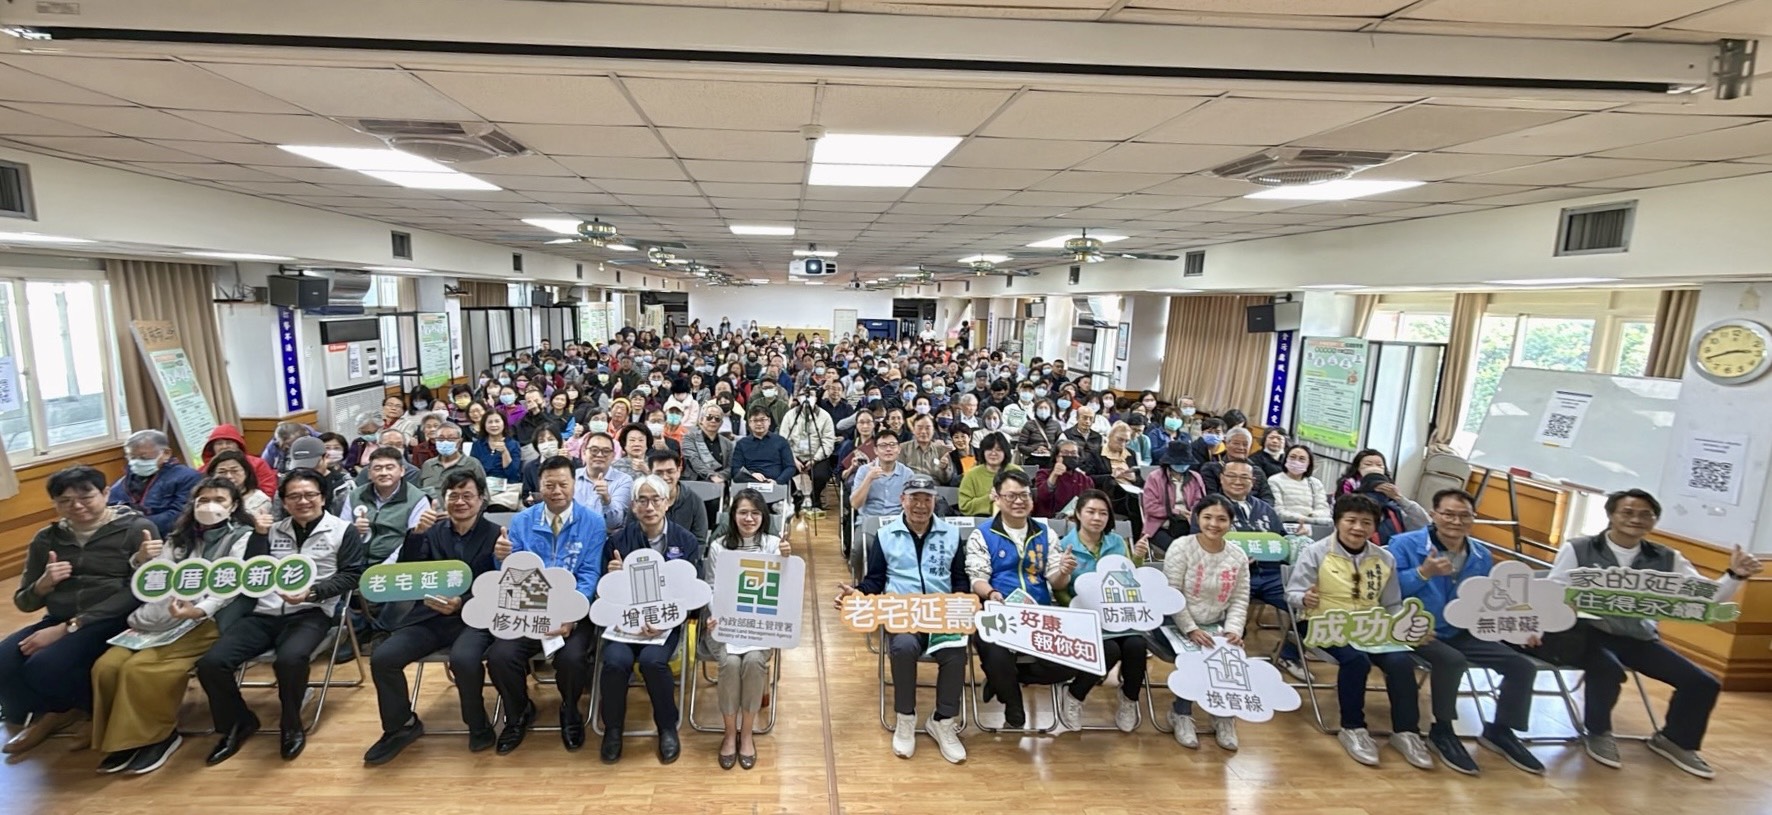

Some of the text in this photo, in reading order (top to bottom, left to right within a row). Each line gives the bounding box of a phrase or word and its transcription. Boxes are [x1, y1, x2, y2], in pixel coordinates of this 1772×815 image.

[144, 564, 305, 591] 舊厝換新衫
[368, 570, 464, 592] 老宅延壽
[1569, 570, 1720, 599] 家的延續
[622, 602, 680, 628] 增電梯
[844, 596, 976, 629] 老宅延壽
[1102, 606, 1154, 623] 防漏水
[1573, 592, 1707, 620] 住得永續
[492, 612, 551, 634] 修外牆
[1020, 610, 1062, 634] 好康
[1309, 611, 1390, 644] 成功
[1477, 615, 1539, 634] 無障礙
[1033, 631, 1097, 662] 報你知
[1206, 690, 1264, 712] 換管線
